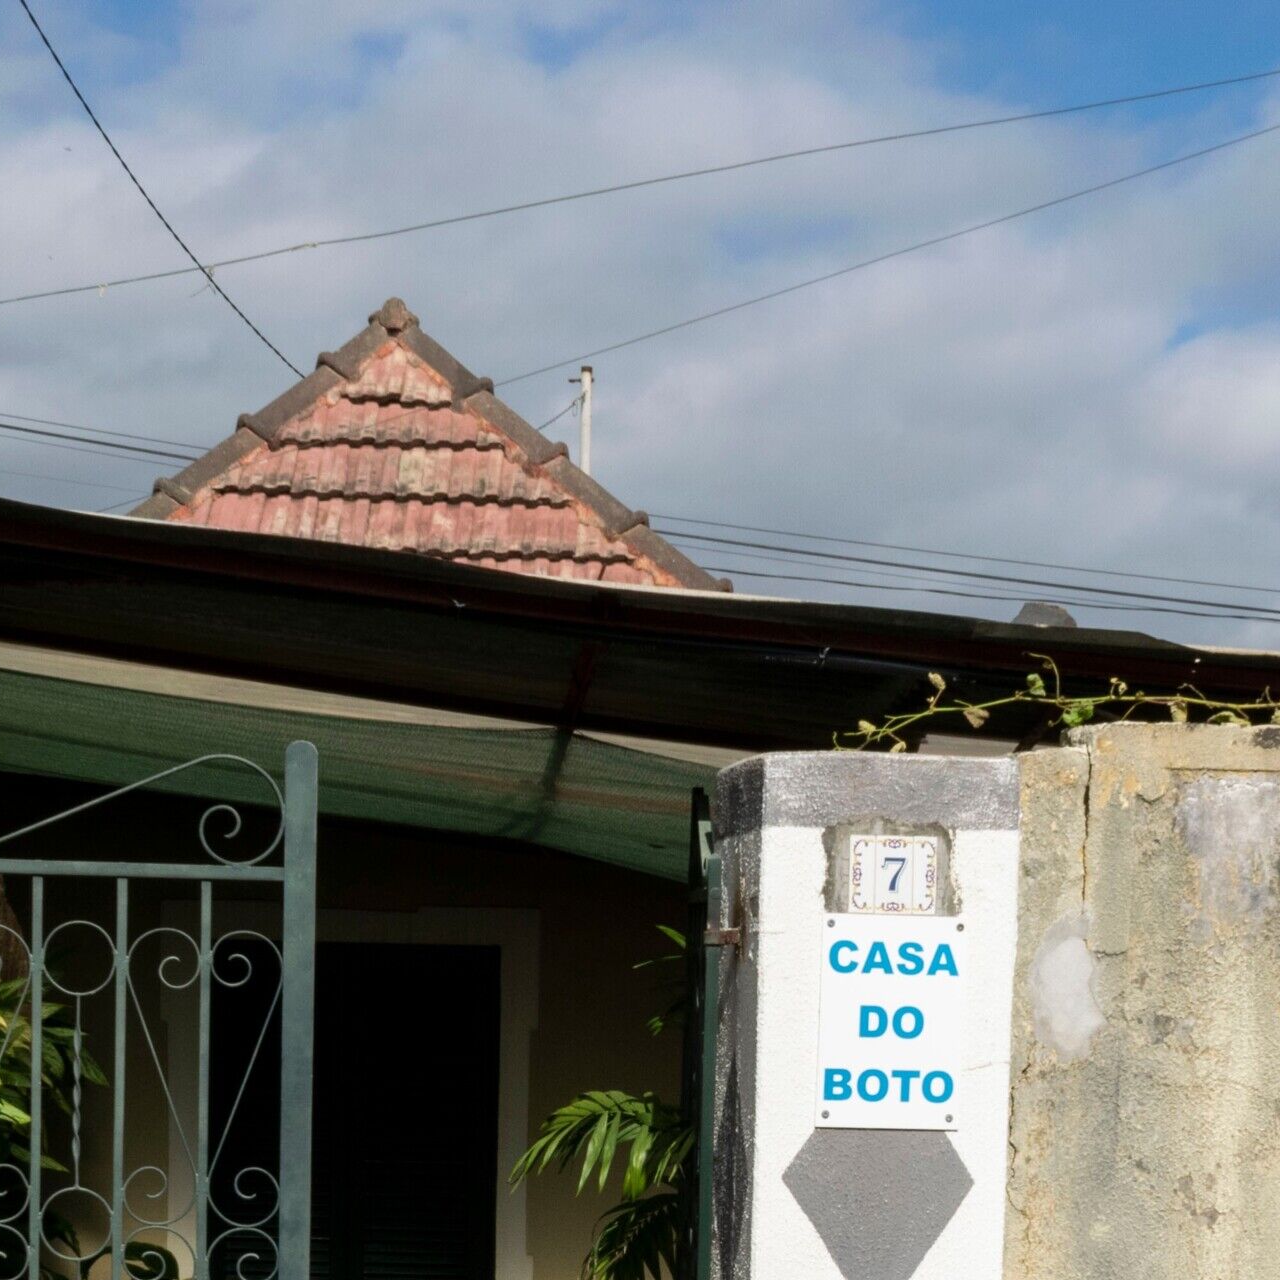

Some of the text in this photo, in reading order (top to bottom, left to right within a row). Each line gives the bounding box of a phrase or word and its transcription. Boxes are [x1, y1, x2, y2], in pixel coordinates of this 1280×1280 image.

[881, 856, 909, 893] 7
[828, 939, 959, 977] CASA
[858, 1004, 925, 1040] DO
[822, 1067, 955, 1104] BOTO
